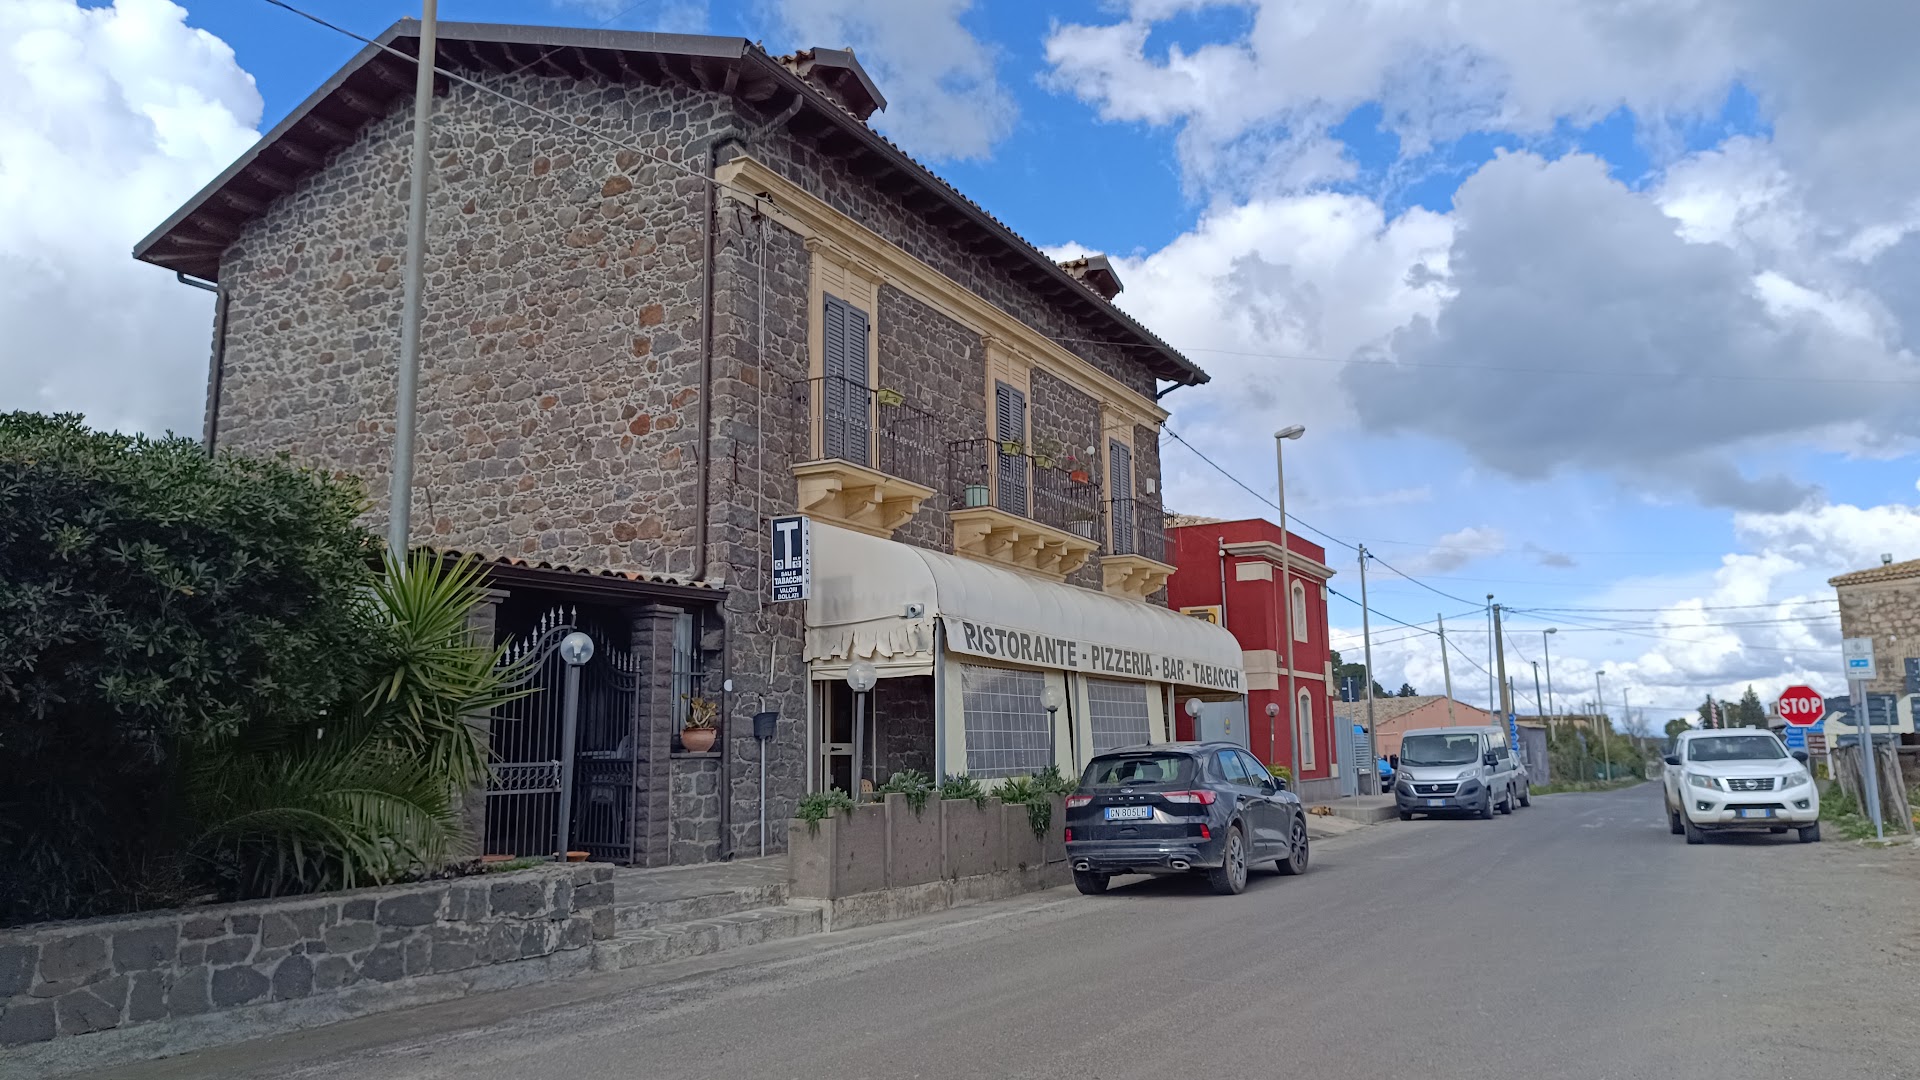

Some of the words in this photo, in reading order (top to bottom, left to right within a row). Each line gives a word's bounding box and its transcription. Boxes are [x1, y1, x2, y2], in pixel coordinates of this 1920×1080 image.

[776, 521, 799, 570] T
[775, 576, 802, 585] TABACCHI
[962, 621, 1077, 667] RISTORANTE
[1091, 645, 1153, 676] PIZZERIA
[1162, 656, 1184, 681] BAR
[1192, 662, 1239, 689] TABACCH
[1780, 696, 1821, 715] STOP
